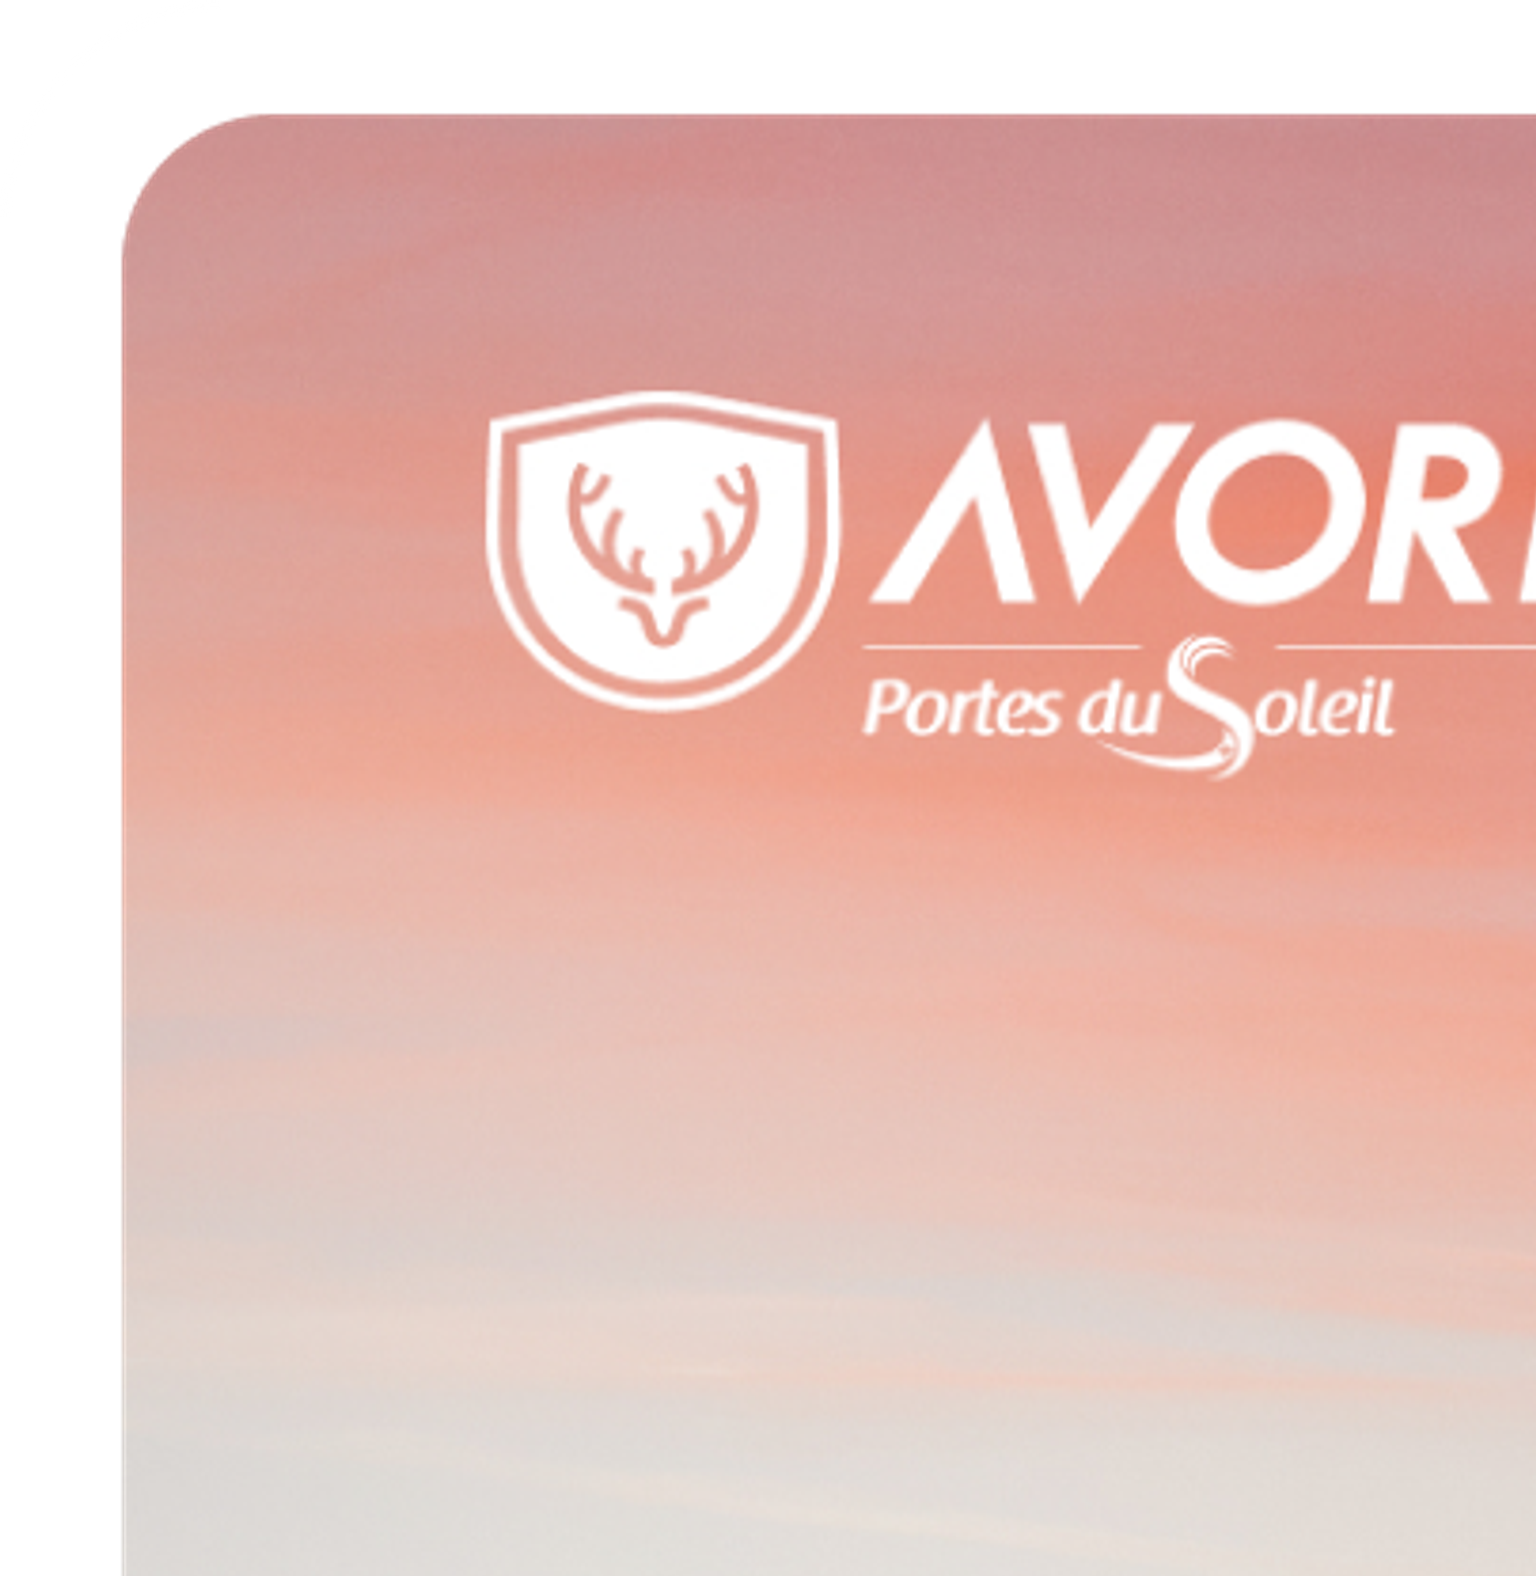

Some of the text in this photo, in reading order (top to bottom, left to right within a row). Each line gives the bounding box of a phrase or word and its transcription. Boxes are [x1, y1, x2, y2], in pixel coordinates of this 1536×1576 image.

[861, 634, 1397, 782] Portes du Soleil
